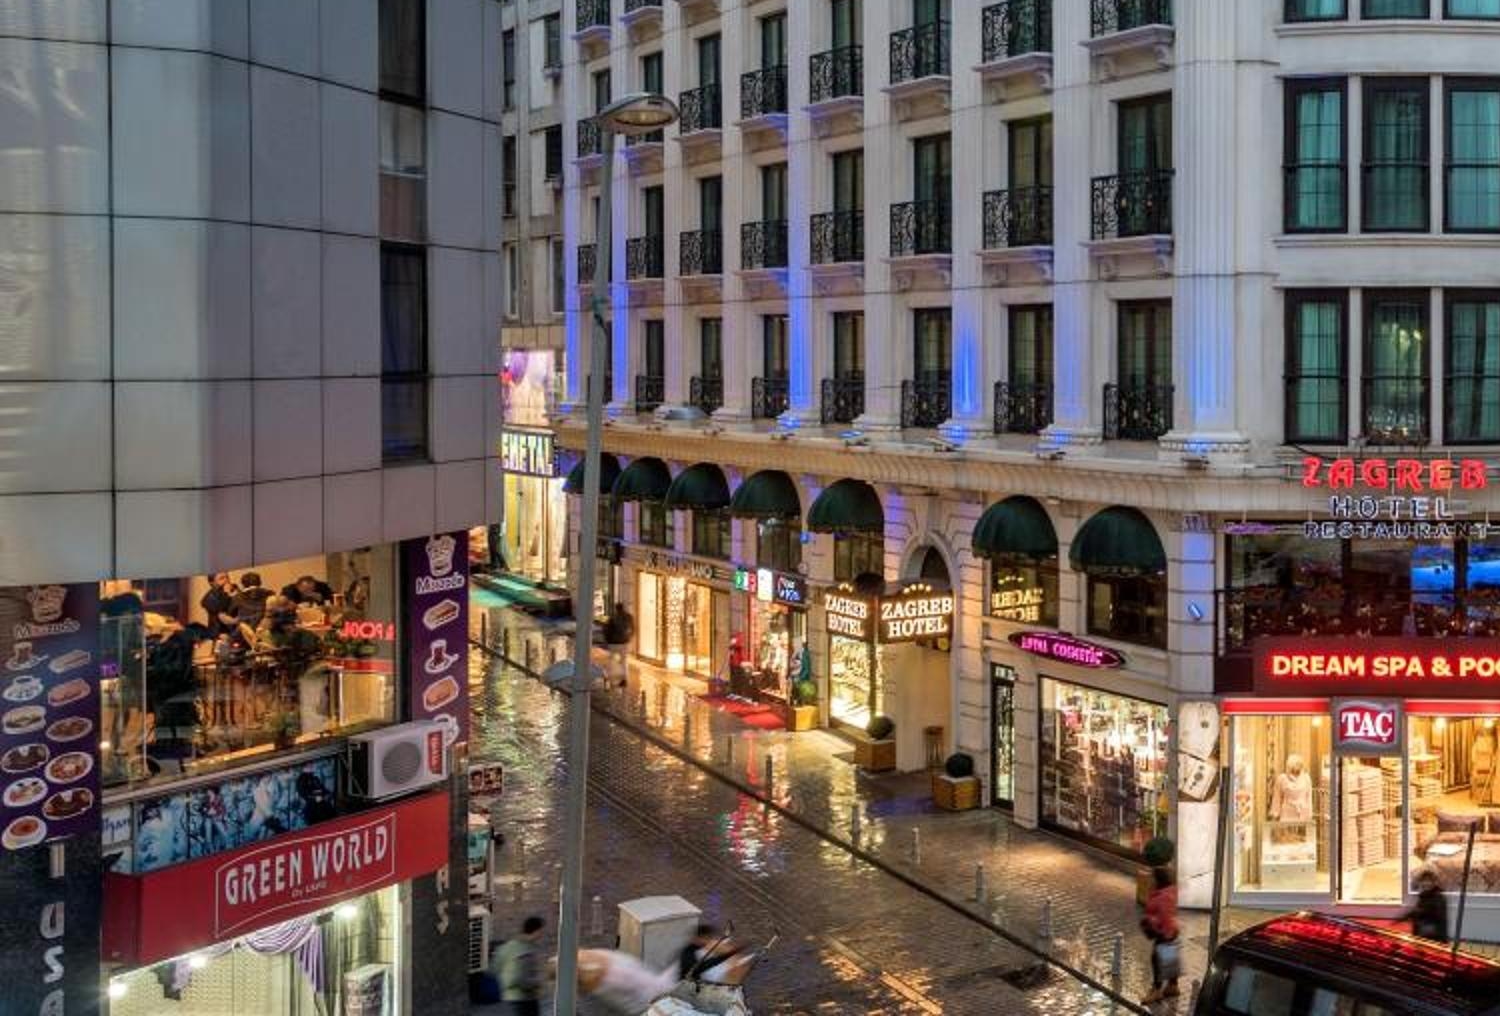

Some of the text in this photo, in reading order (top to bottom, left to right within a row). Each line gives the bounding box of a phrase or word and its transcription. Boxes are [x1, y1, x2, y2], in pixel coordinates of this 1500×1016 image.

[1303, 456, 1487, 490] ZAGREB
[1330, 495, 1454, 520] HOTEL
[1304, 521, 1491, 539] RESTAURANT
[825, 594, 867, 619] ZAGREB
[881, 597, 953, 620] ZAGREB
[828, 613, 865, 636] HOTEL
[888, 616, 948, 638] HOTEL
[1272, 655, 1366, 676] DREAM
[1372, 656, 1425, 677] SPA
[1431, 657, 1453, 677] &
[1341, 711, 1393, 742] TAÇ
[225, 825, 388, 905] GREEN WORLD
